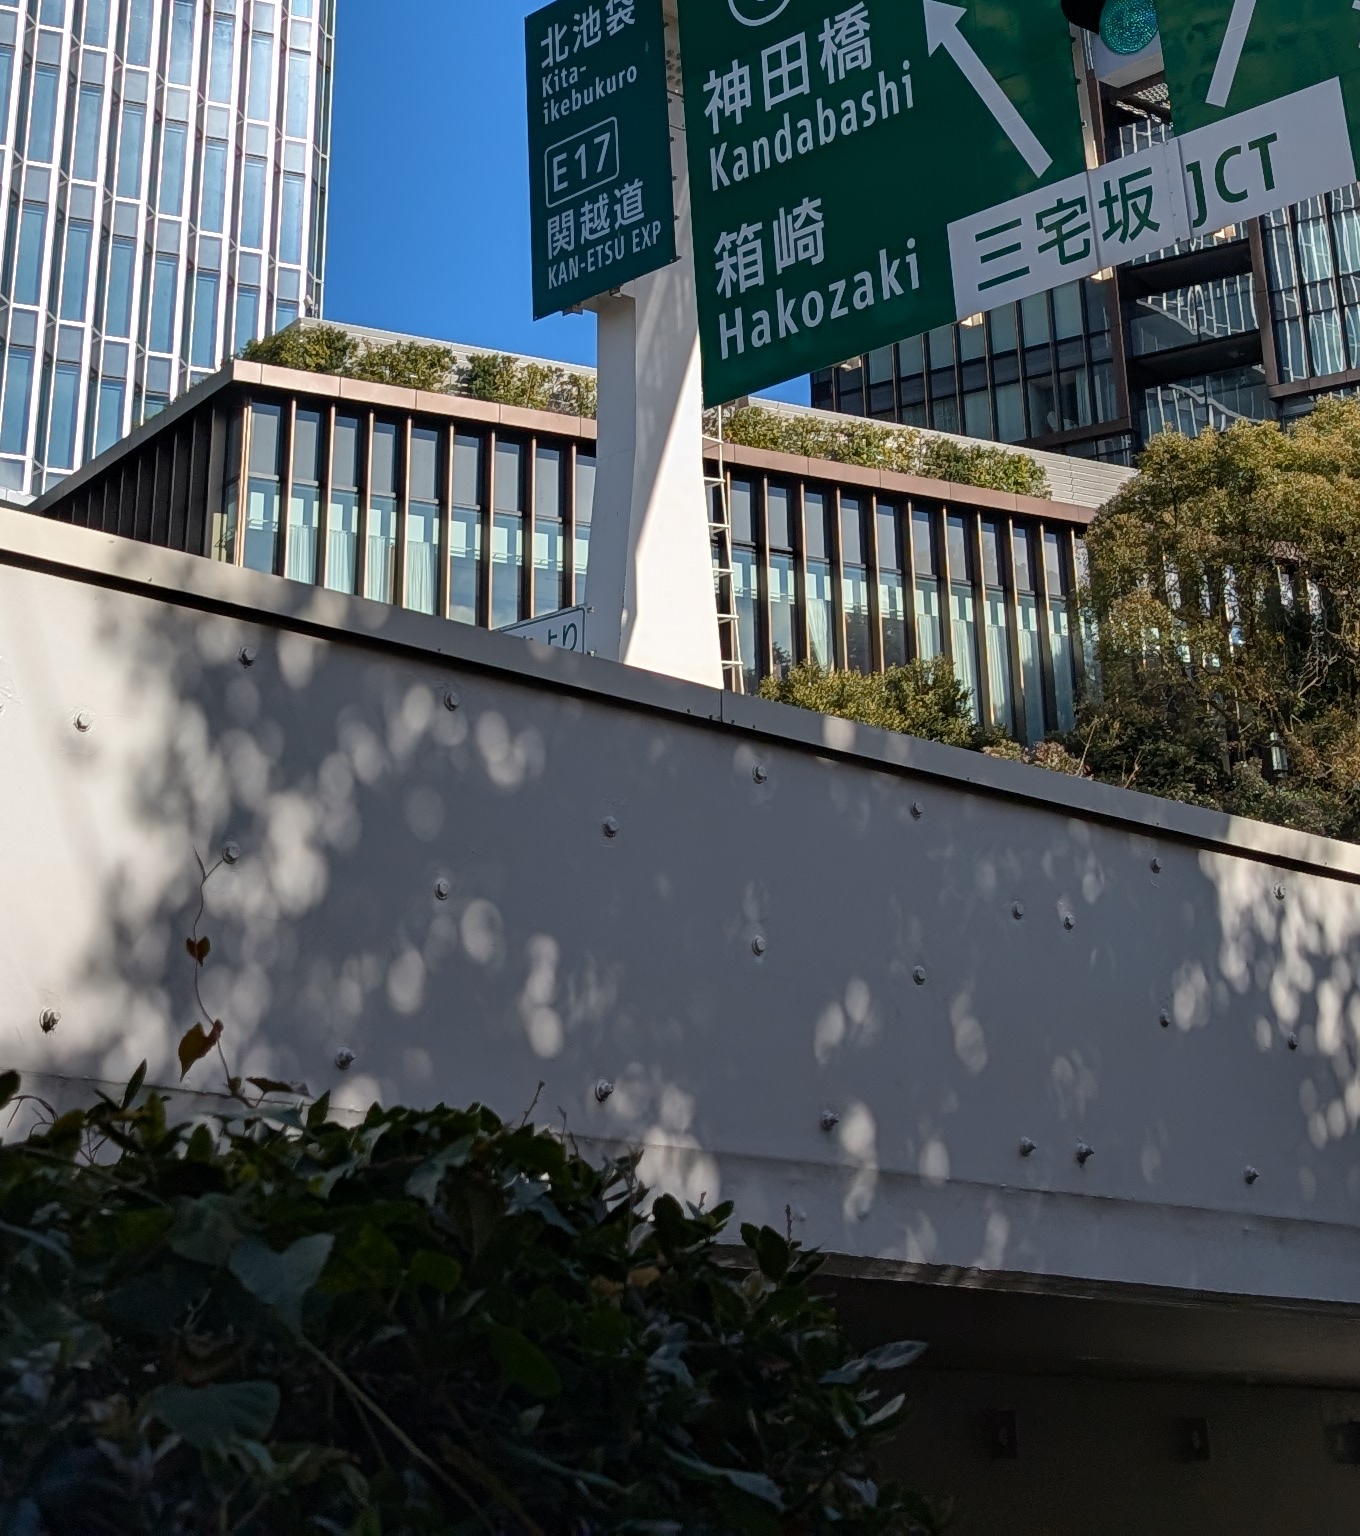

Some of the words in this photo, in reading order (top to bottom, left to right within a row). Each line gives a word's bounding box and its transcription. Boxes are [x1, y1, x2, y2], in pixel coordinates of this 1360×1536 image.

[541, 65, 587, 98] Kita-
[543, 65, 638, 125] ikebukuro
[702, 1, 872, 135] 神田橋
[709, 59, 914, 192] Kandabashi
[547, 178, 645, 260] 関越道
[548, 235, 625, 290] KAN-ETSU
[631, 220, 662, 254] EXP
[713, 197, 825, 299] 箱崎
[974, 166, 1161, 292] 三宅坂
[1185, 131, 1278, 226] JCT
[718, 237, 920, 361] Hakozaki
